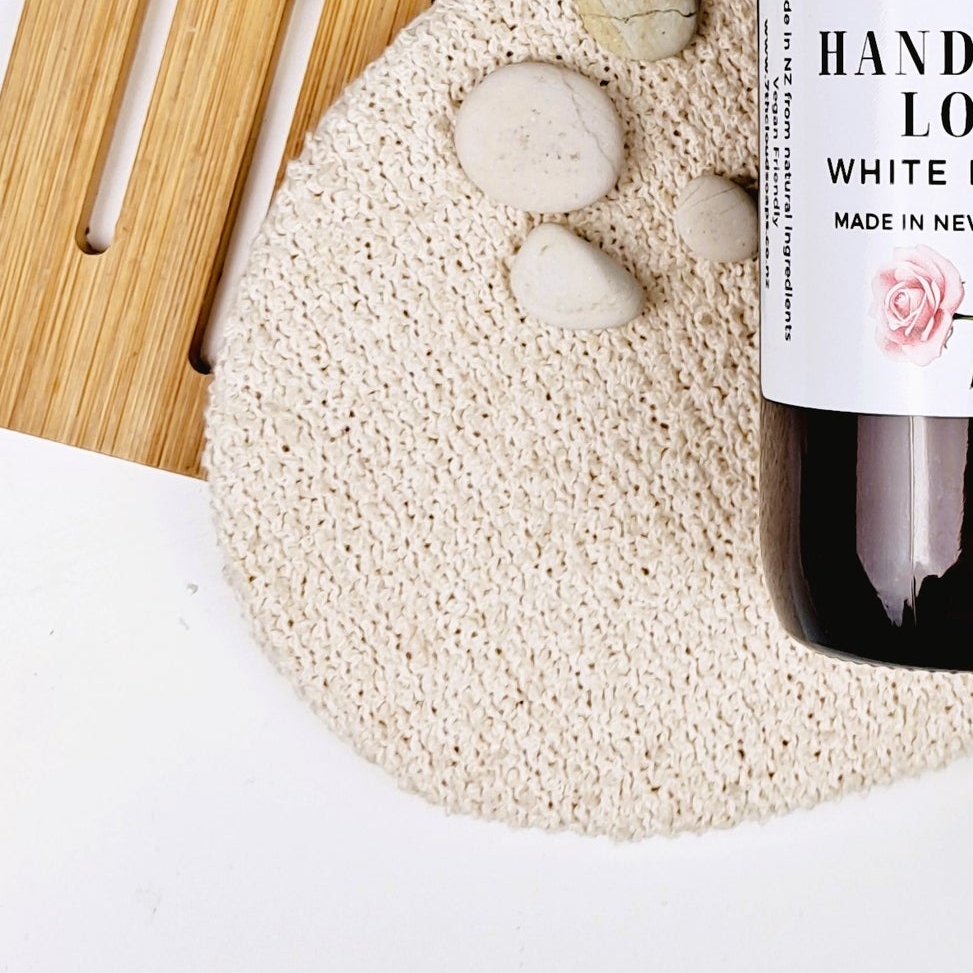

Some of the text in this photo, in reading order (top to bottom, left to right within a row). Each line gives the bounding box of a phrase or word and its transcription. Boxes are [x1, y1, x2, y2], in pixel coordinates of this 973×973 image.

[783, 57, 792, 86] NZ
[819, 31, 973, 75] HAND
[784, 92, 792, 140] from
[772, 76, 780, 228] Vegan Friendly
[827, 158, 946, 185] WHITE
[784, 147, 793, 219] natural
[835, 212, 892, 230] MADE
[903, 214, 923, 230] IN
